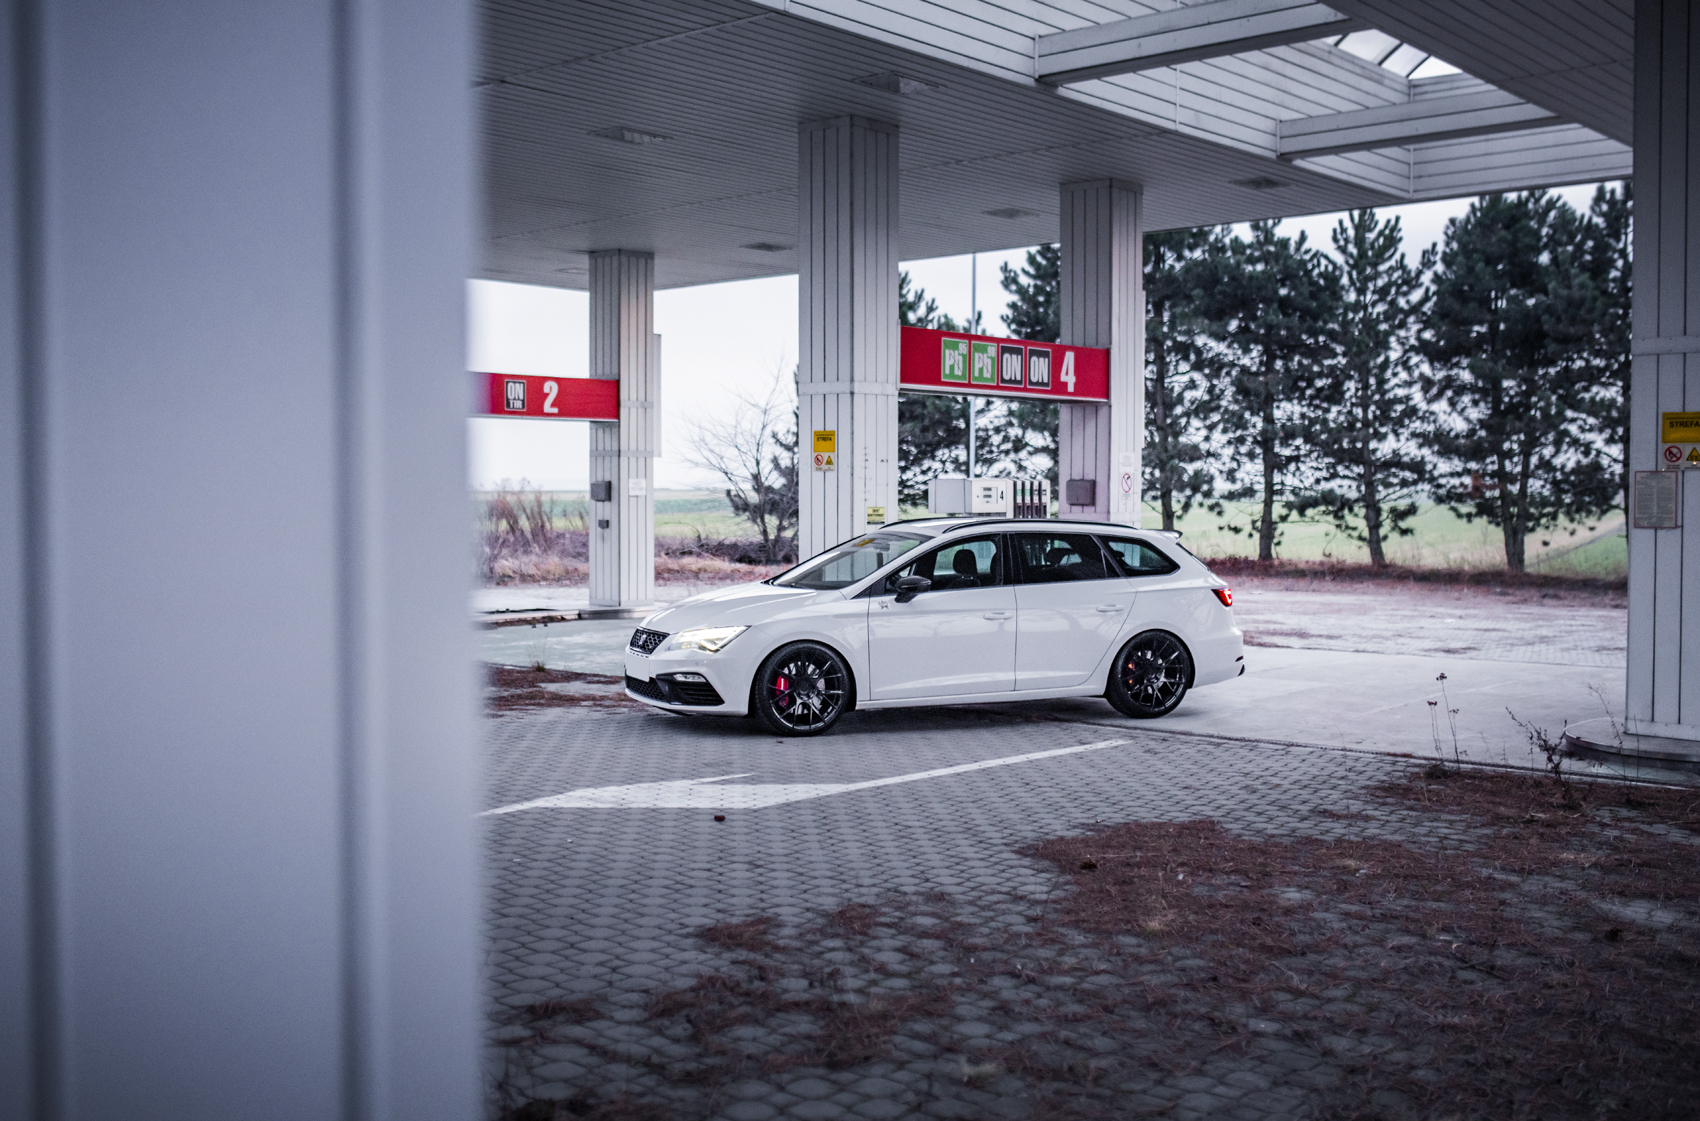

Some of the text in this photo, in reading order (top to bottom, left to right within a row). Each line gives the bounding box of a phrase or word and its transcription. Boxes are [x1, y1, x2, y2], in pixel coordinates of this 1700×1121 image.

[1002, 353, 1022, 381] ON
[1030, 356, 1049, 383] ON
[1060, 351, 1077, 392] 4
[507, 381, 559, 413] ON 2
[509, 400, 523, 409] TIR
[1669, 420, 1700, 428] STREFA
